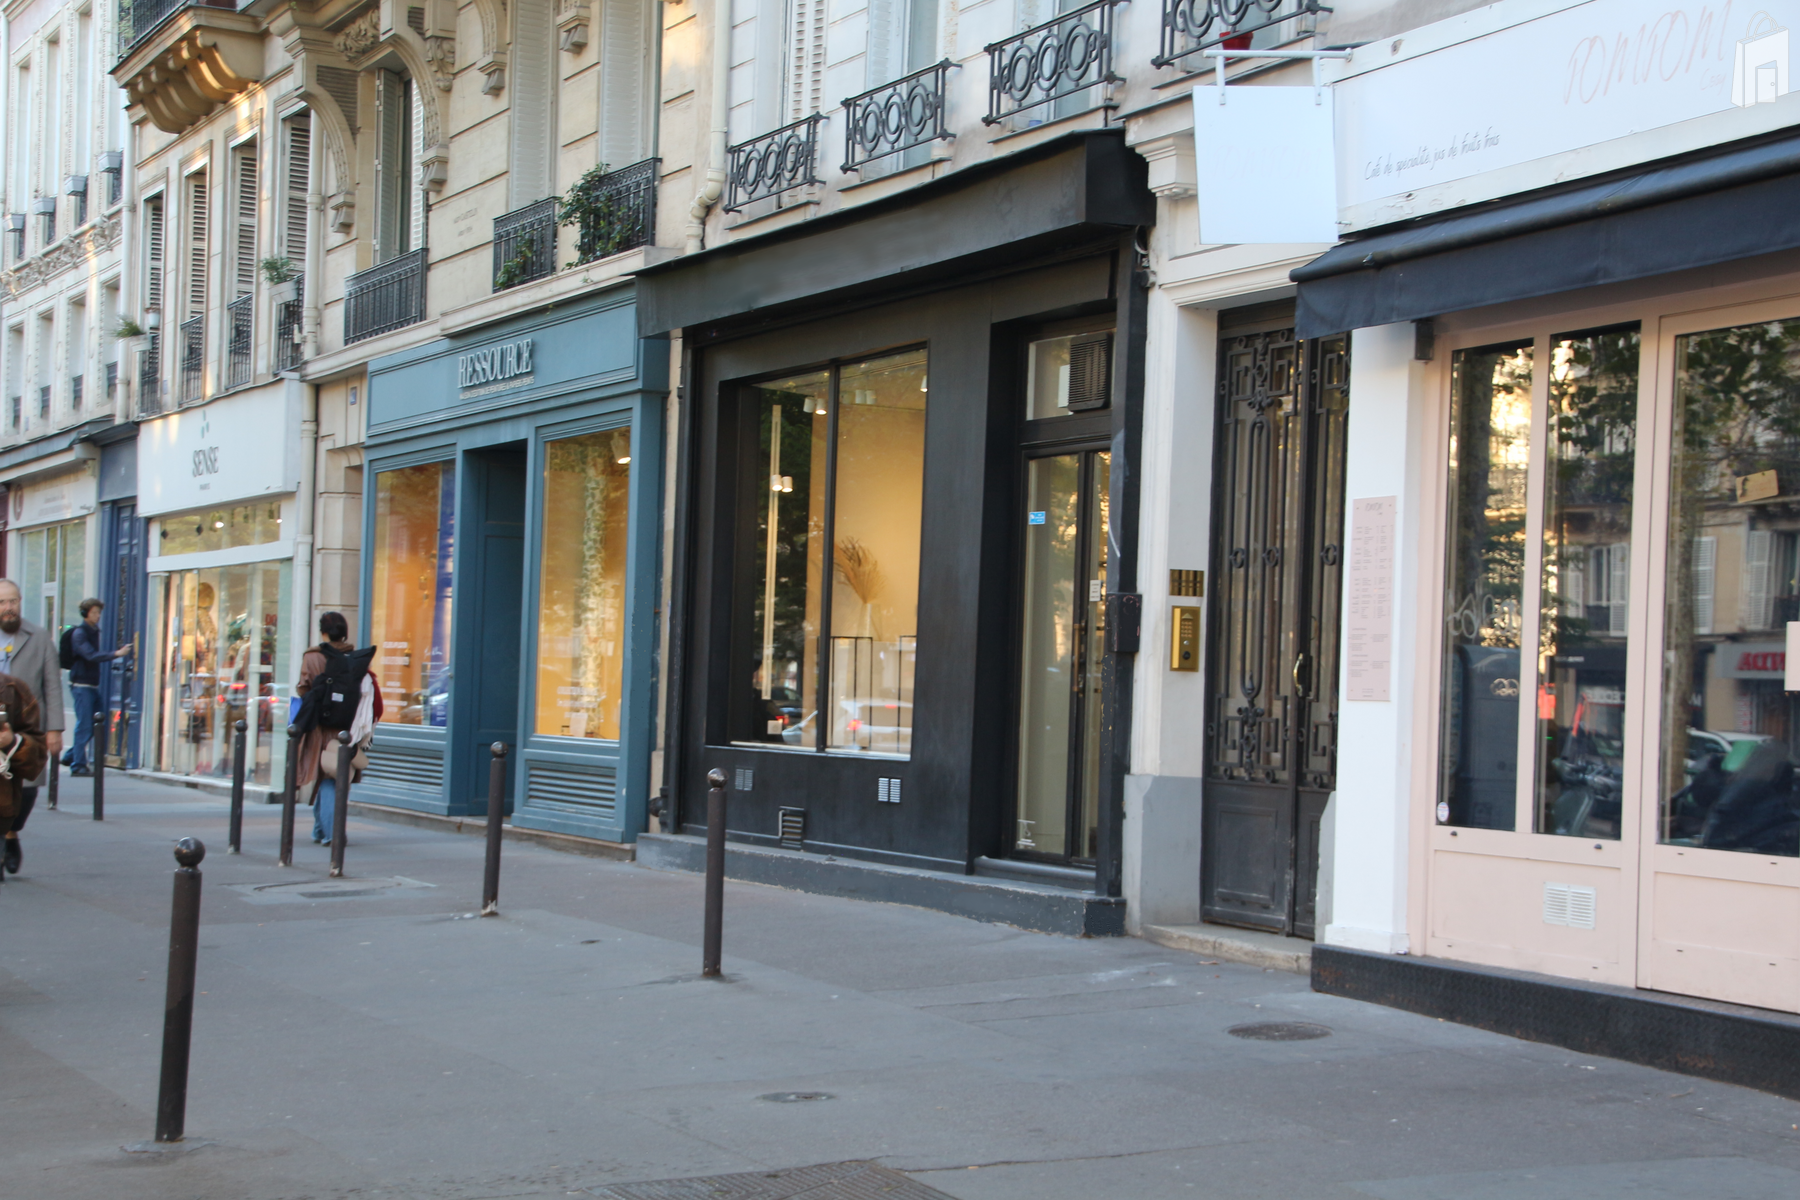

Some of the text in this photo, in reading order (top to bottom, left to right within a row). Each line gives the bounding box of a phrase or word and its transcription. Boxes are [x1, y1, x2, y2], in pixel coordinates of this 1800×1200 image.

[1460, 131, 1482, 155] fruits
[1483, 125, 1501, 150] frais
[458, 339, 532, 388] RESSOURCE
[192, 445, 219, 478] SENSE
